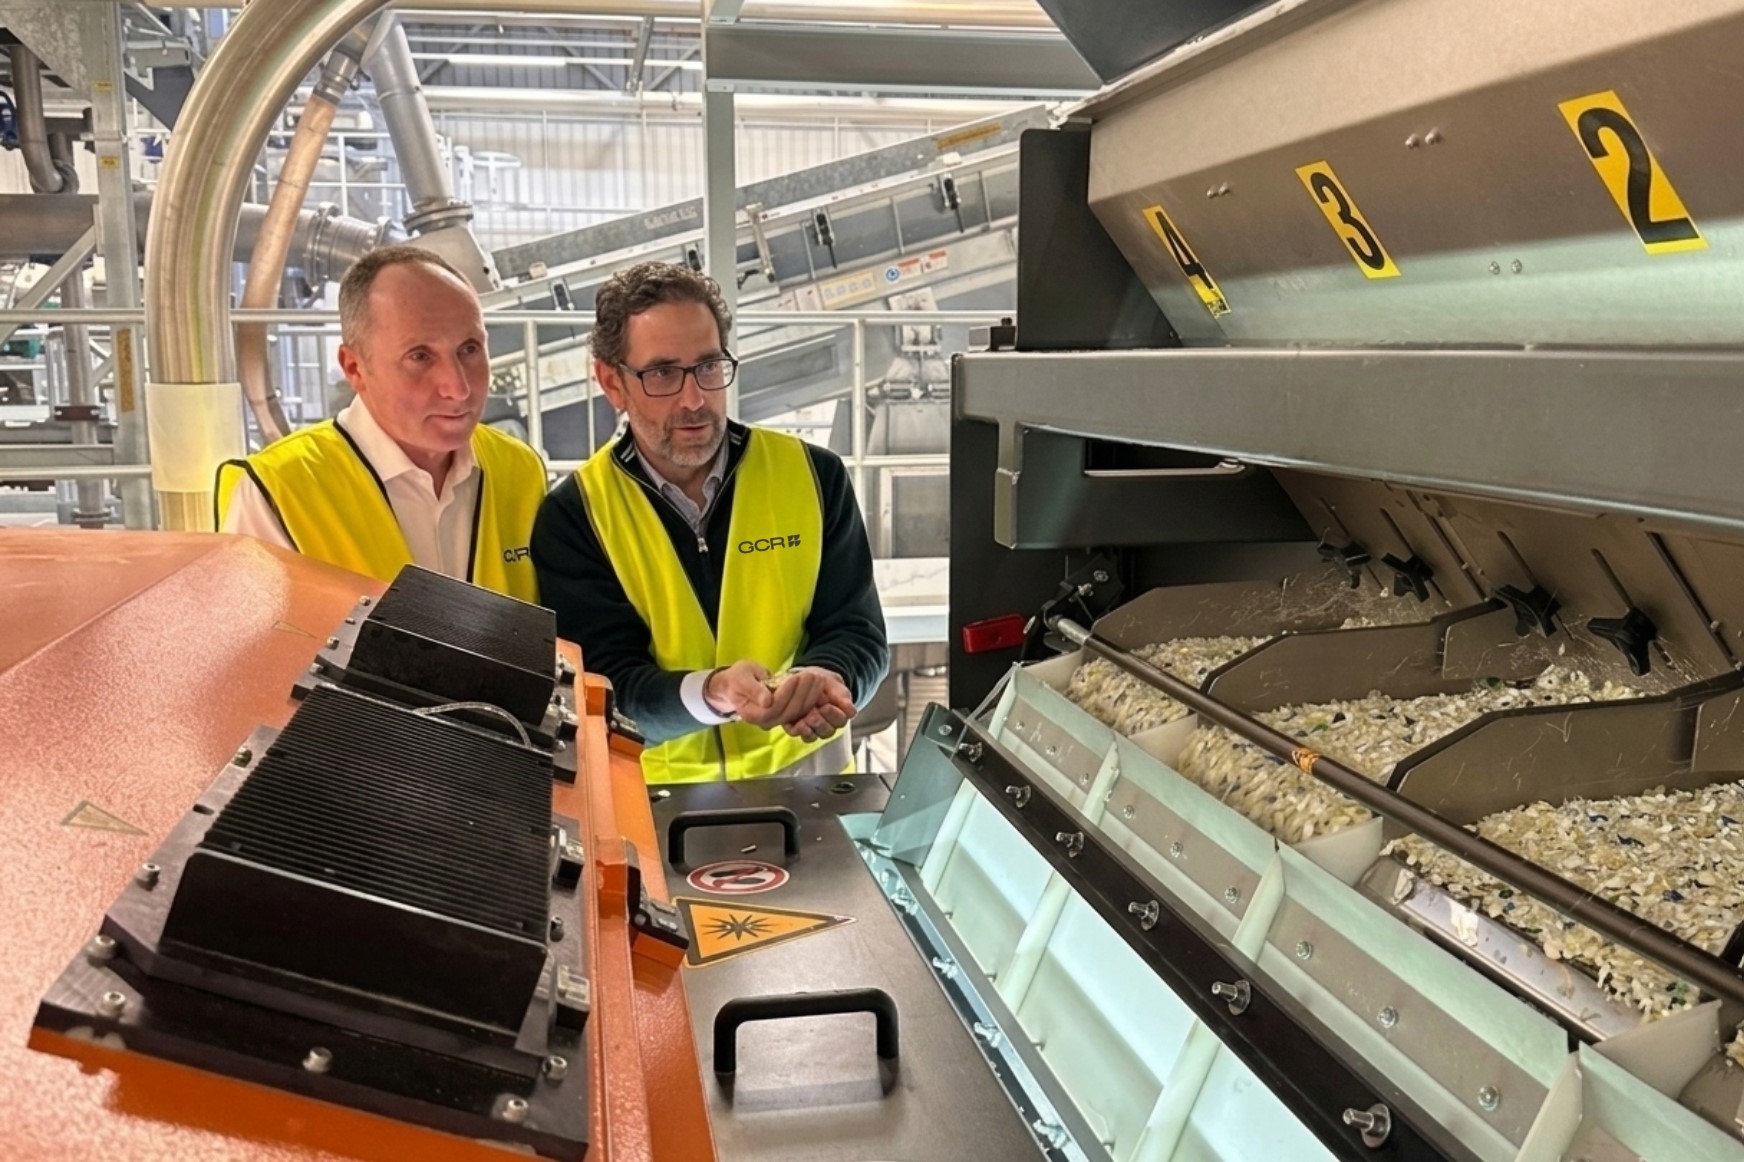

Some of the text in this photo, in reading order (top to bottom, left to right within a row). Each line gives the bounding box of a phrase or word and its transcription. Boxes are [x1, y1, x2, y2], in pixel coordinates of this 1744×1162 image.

[1578, 107, 1699, 244] 2
[1155, 211, 1213, 289] 4
[1310, 172, 1385, 270] 3
[738, 536, 786, 554] GCR
